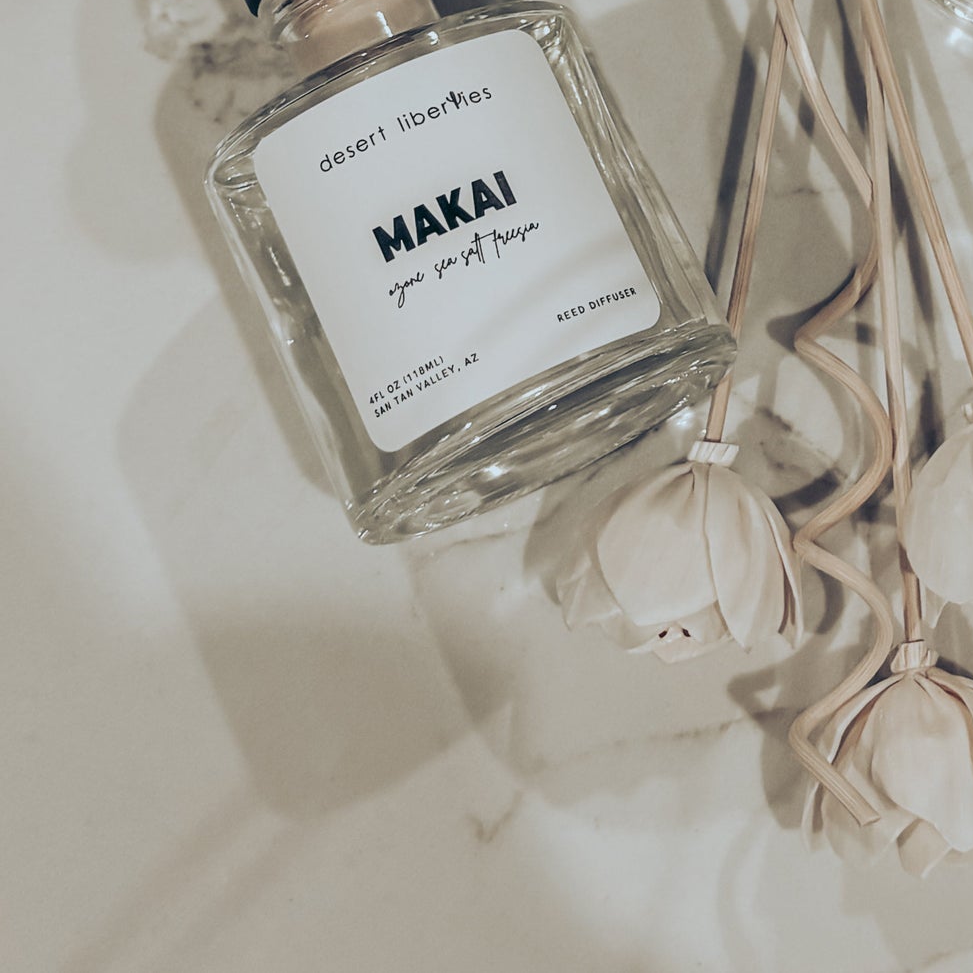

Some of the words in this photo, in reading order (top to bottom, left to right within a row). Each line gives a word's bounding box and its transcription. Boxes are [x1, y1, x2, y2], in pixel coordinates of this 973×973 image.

[319, 125, 388, 174] desert
[396, 87, 493, 133] liberties
[371, 170, 518, 264] MAKAI
[434, 256, 458, 280] sea
[460, 232, 487, 267] salt
[492, 221, 540, 259] freesia
[556, 304, 586, 323] REED
[588, 286, 638, 312] DIFFUSER
[369, 390, 385, 405] 4FL
[386, 379, 401, 394] OZ
[402, 355, 445, 384] (118ML)
[374, 401, 392, 418] SAN
[393, 388, 414, 405] TAN
[415, 364, 461, 392] VALLEY,
[464, 352, 480, 367] AZ
